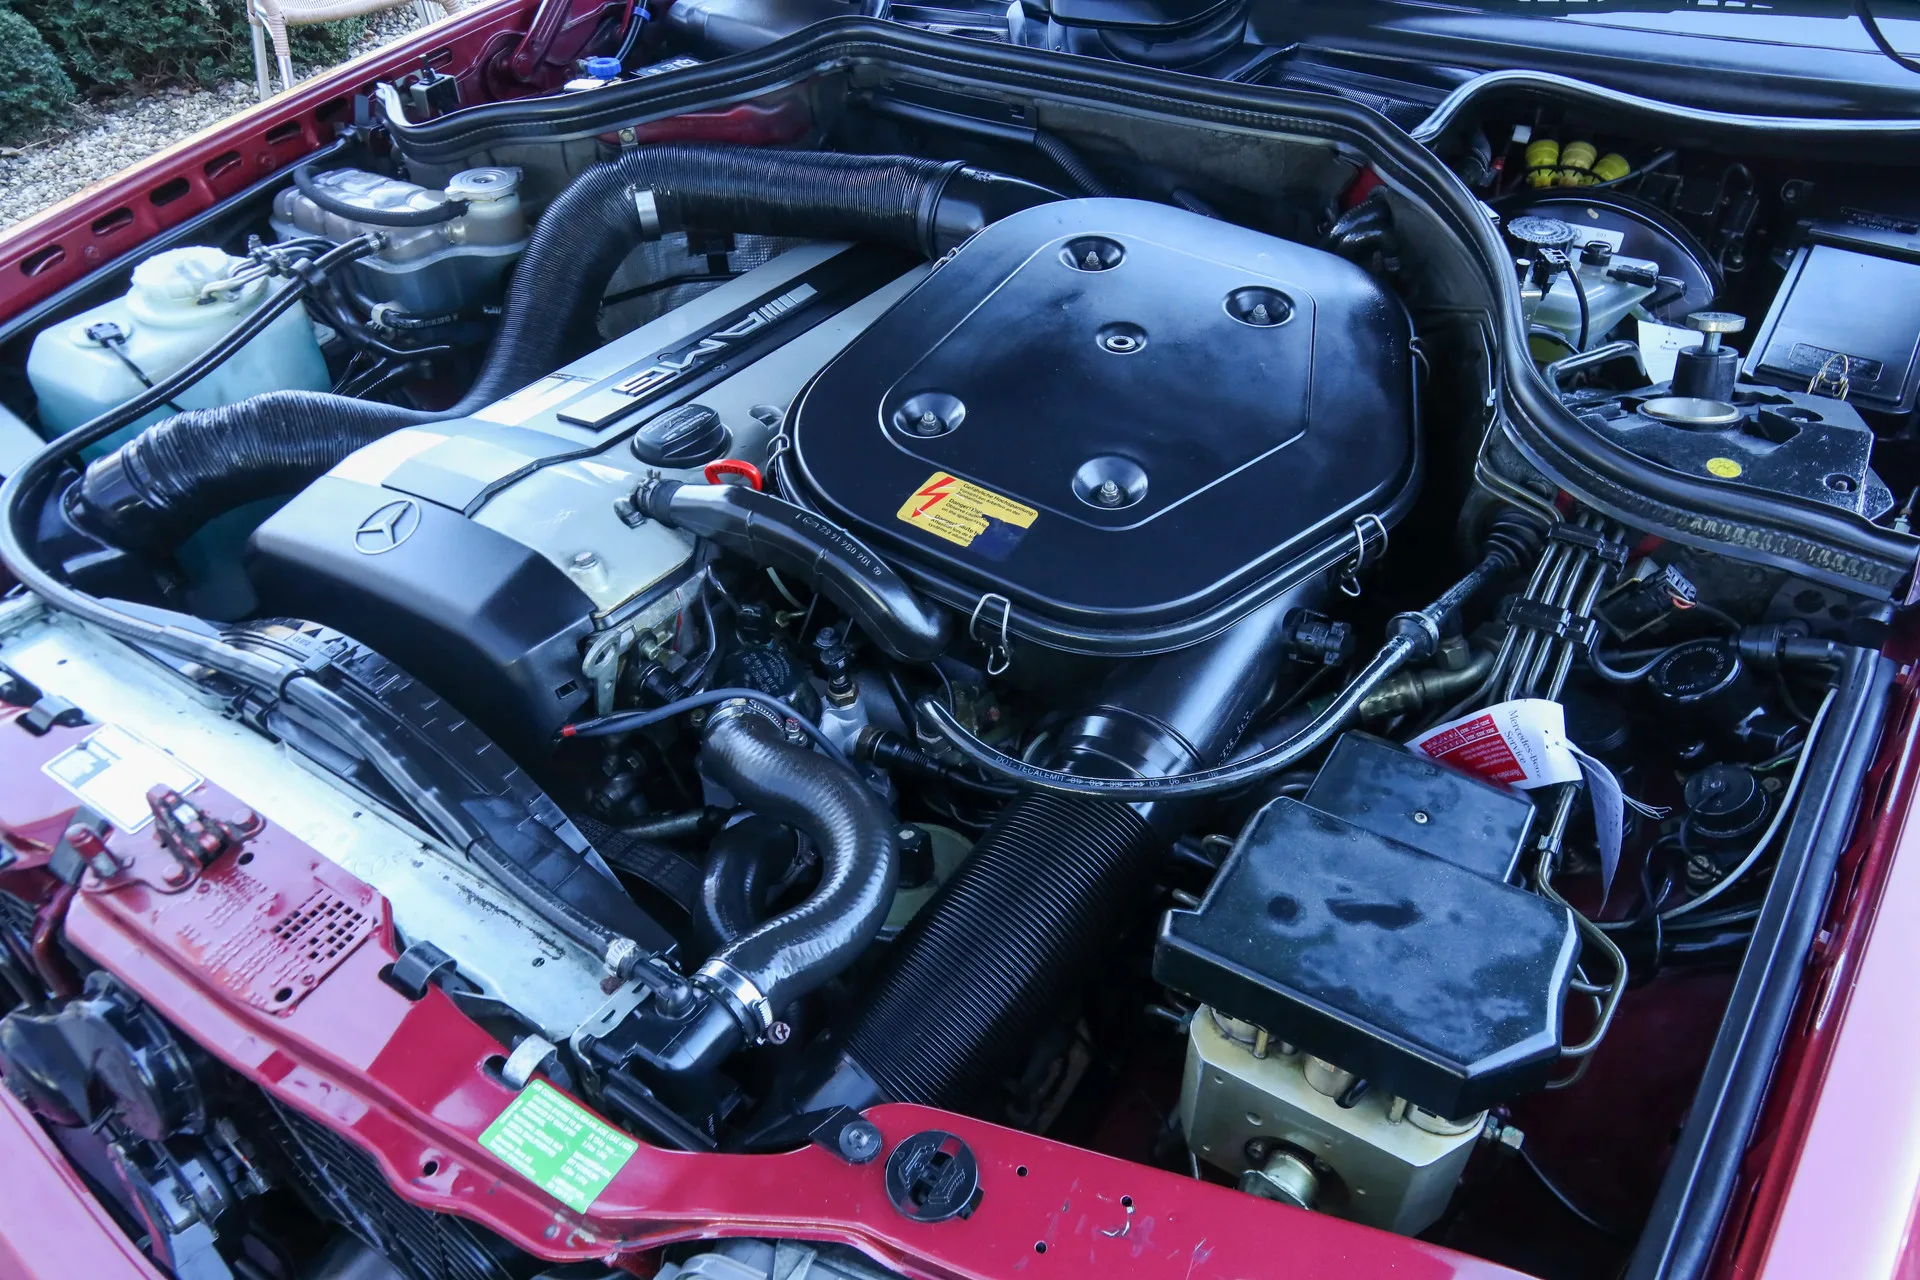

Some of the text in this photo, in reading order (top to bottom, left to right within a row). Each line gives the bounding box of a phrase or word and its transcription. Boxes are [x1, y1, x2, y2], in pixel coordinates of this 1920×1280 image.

[612, 300, 790, 397] AMG
[1504, 730, 1527, 763] Service
[1508, 709, 1541, 778] Mercedes-Benz
[1016, 764, 1065, 782] TECALEMIT
